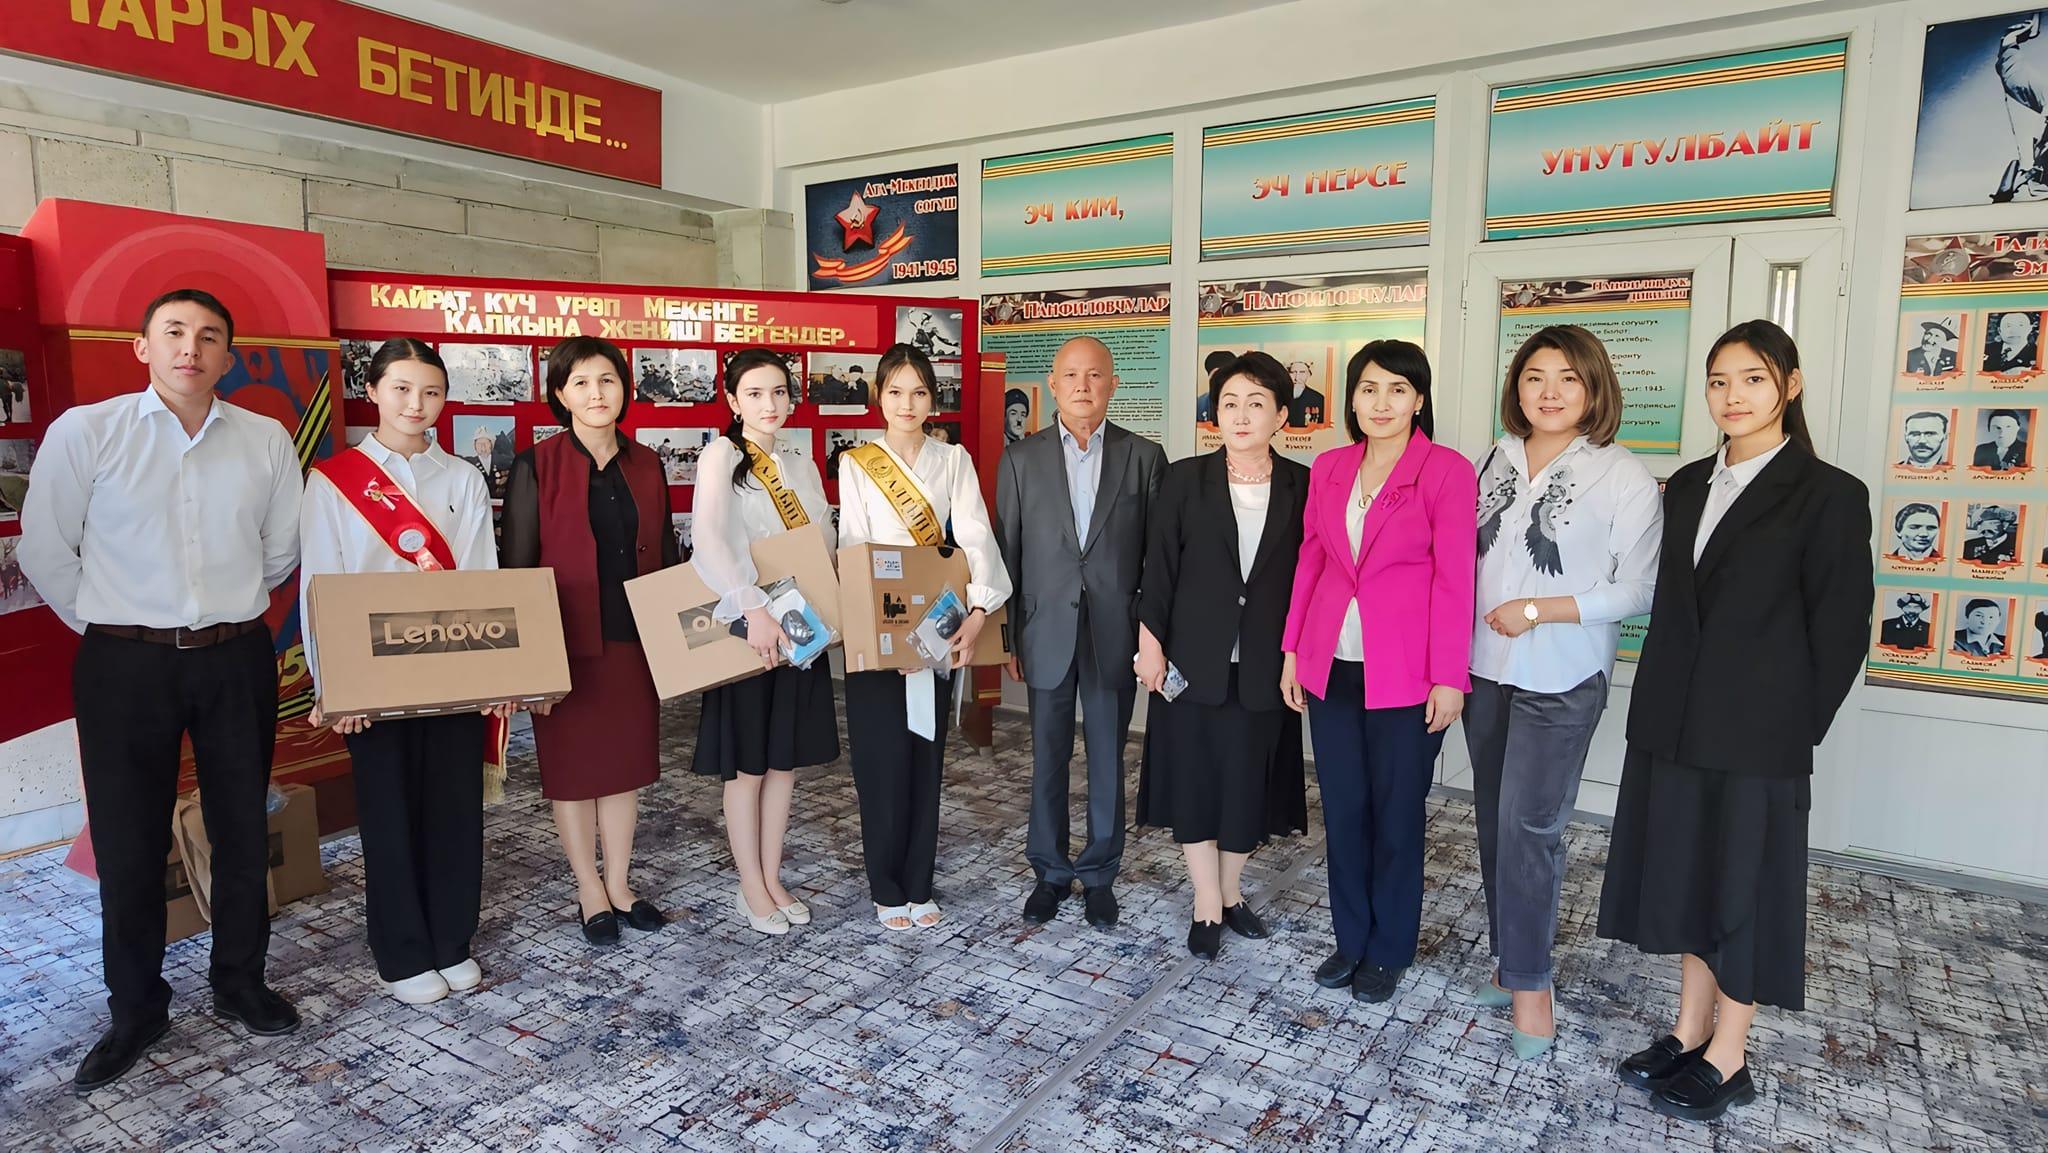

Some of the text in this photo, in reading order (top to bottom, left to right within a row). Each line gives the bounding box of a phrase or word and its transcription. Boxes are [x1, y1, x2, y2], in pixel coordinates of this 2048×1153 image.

[1540, 119, 1822, 176] УНУТУЛБАЙТ
[1252, 160, 1408, 200] ЭЧ НЕРСЕ
[1024, 195, 1125, 225] ЭЧ КИМ,
[892, 259, 957, 279] 1941-1945
[444, 308, 582, 337] КАЛКЫНА
[384, 619, 507, 646] Lenovo
